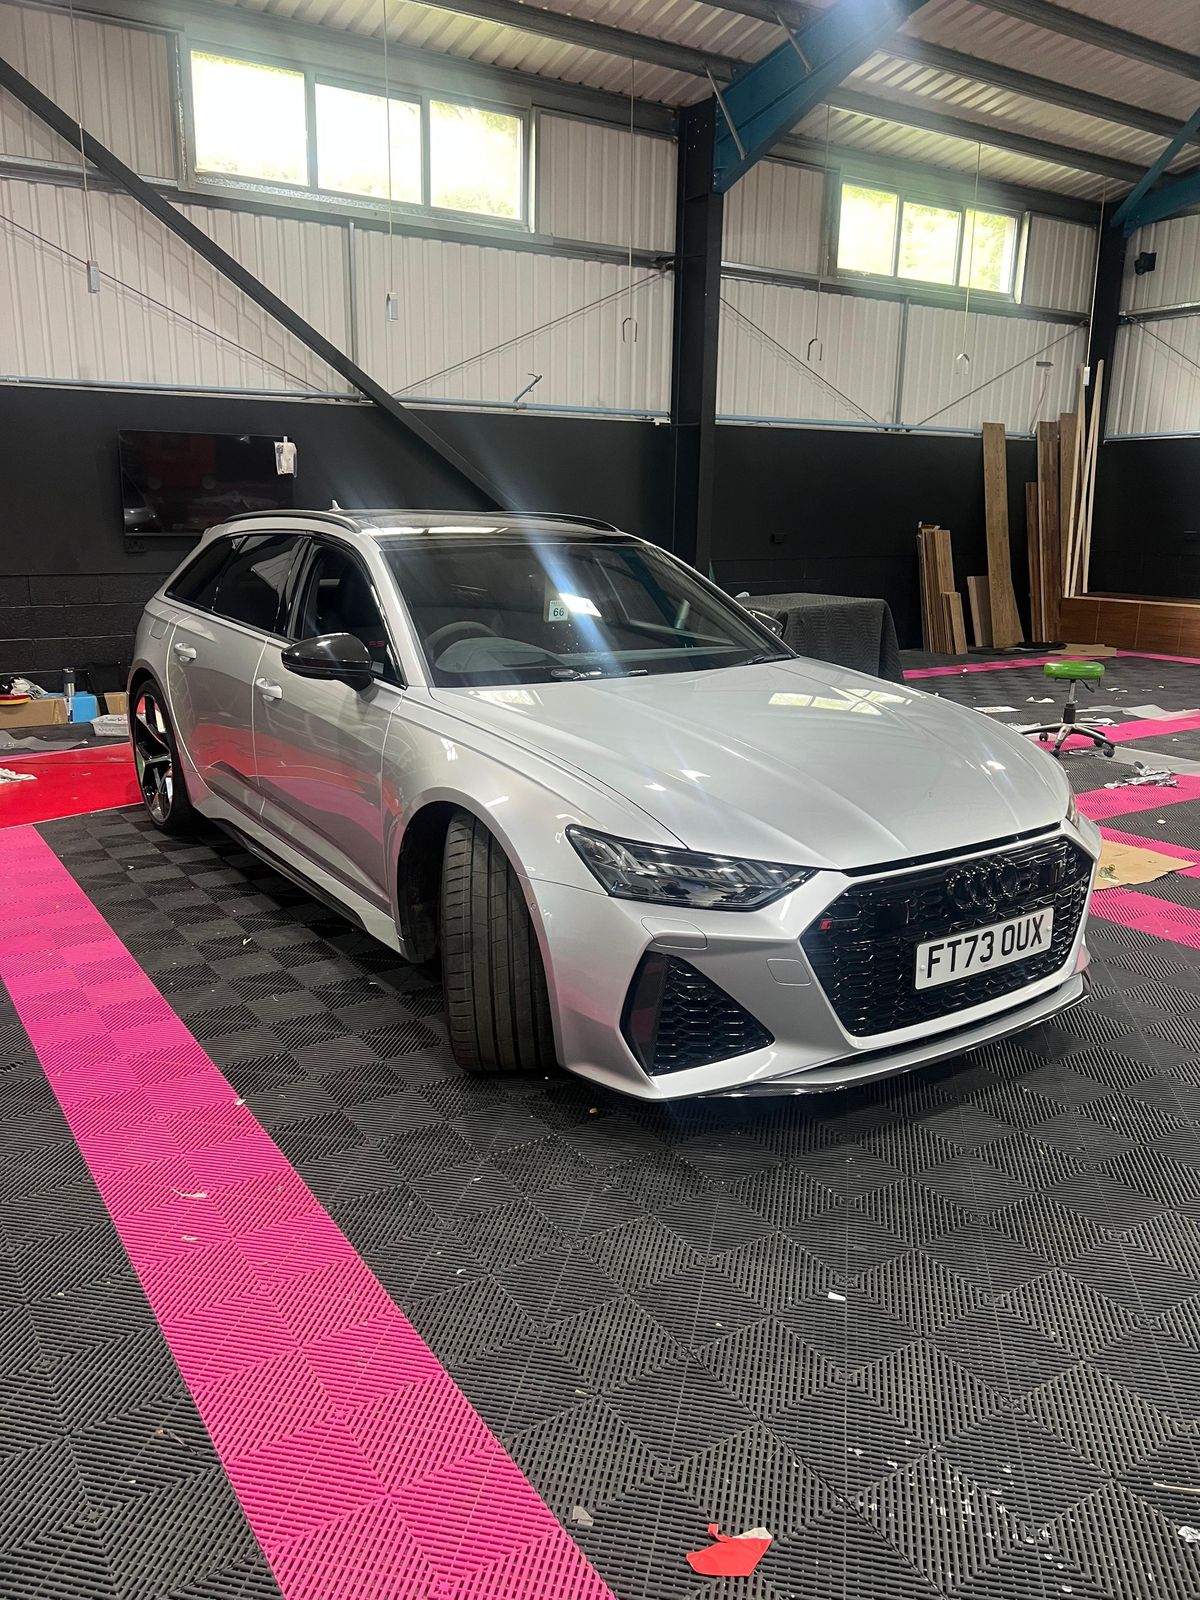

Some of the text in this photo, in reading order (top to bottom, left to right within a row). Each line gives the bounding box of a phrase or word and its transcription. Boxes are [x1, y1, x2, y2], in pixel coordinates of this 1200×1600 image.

[553, 608, 565, 617] 66
[927, 914, 1045, 979] FT73 OUX
